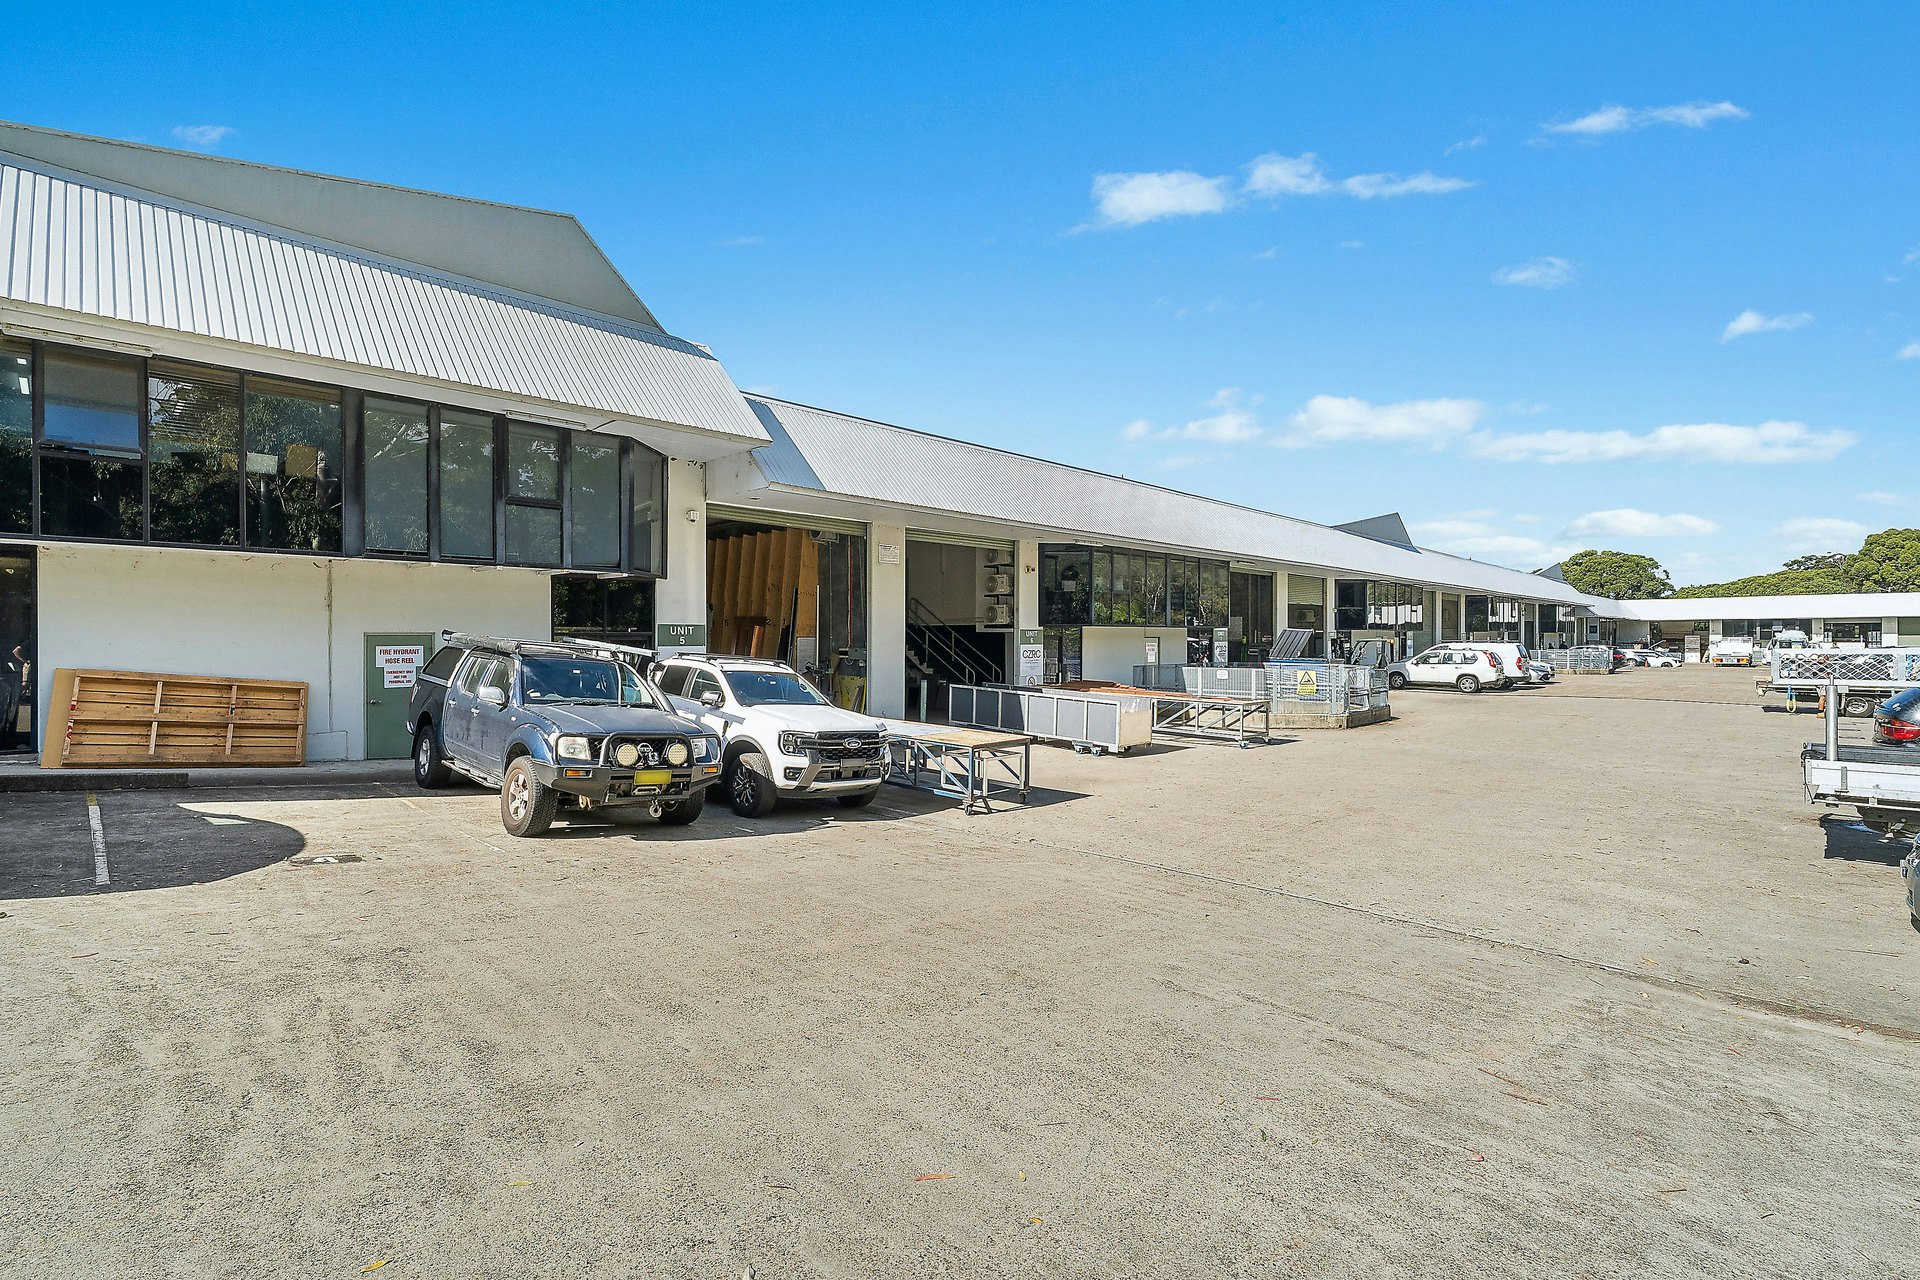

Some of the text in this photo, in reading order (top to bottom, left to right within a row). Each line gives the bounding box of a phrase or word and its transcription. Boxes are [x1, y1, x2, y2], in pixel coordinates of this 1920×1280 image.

[670, 626, 695, 635] UNIT
[679, 636, 686, 645] 5
[1022, 649, 1041, 659] CZRC
